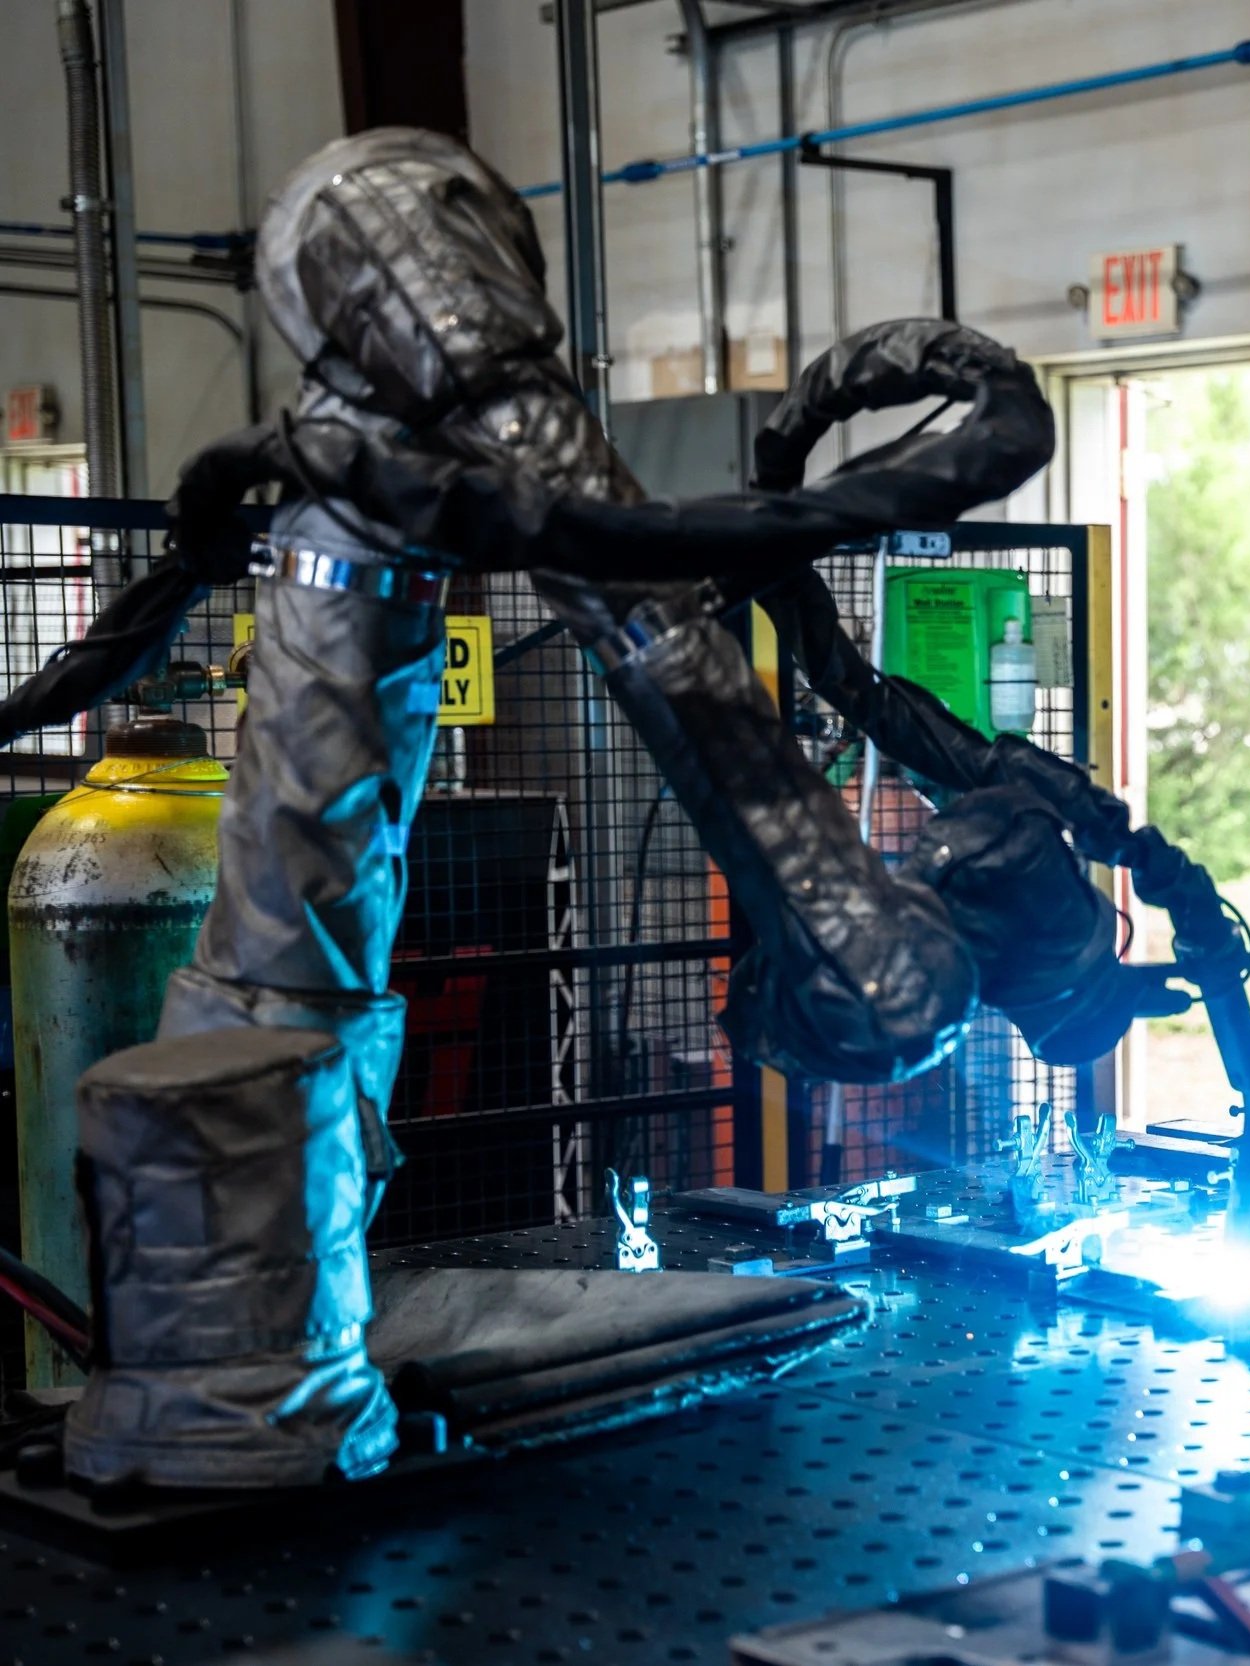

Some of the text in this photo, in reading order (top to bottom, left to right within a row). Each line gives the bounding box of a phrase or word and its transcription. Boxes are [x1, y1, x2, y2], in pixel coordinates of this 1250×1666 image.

[1104, 251, 1163, 326] EXIT
[445, 638, 470, 669] D
[440, 679, 470, 706] LY
